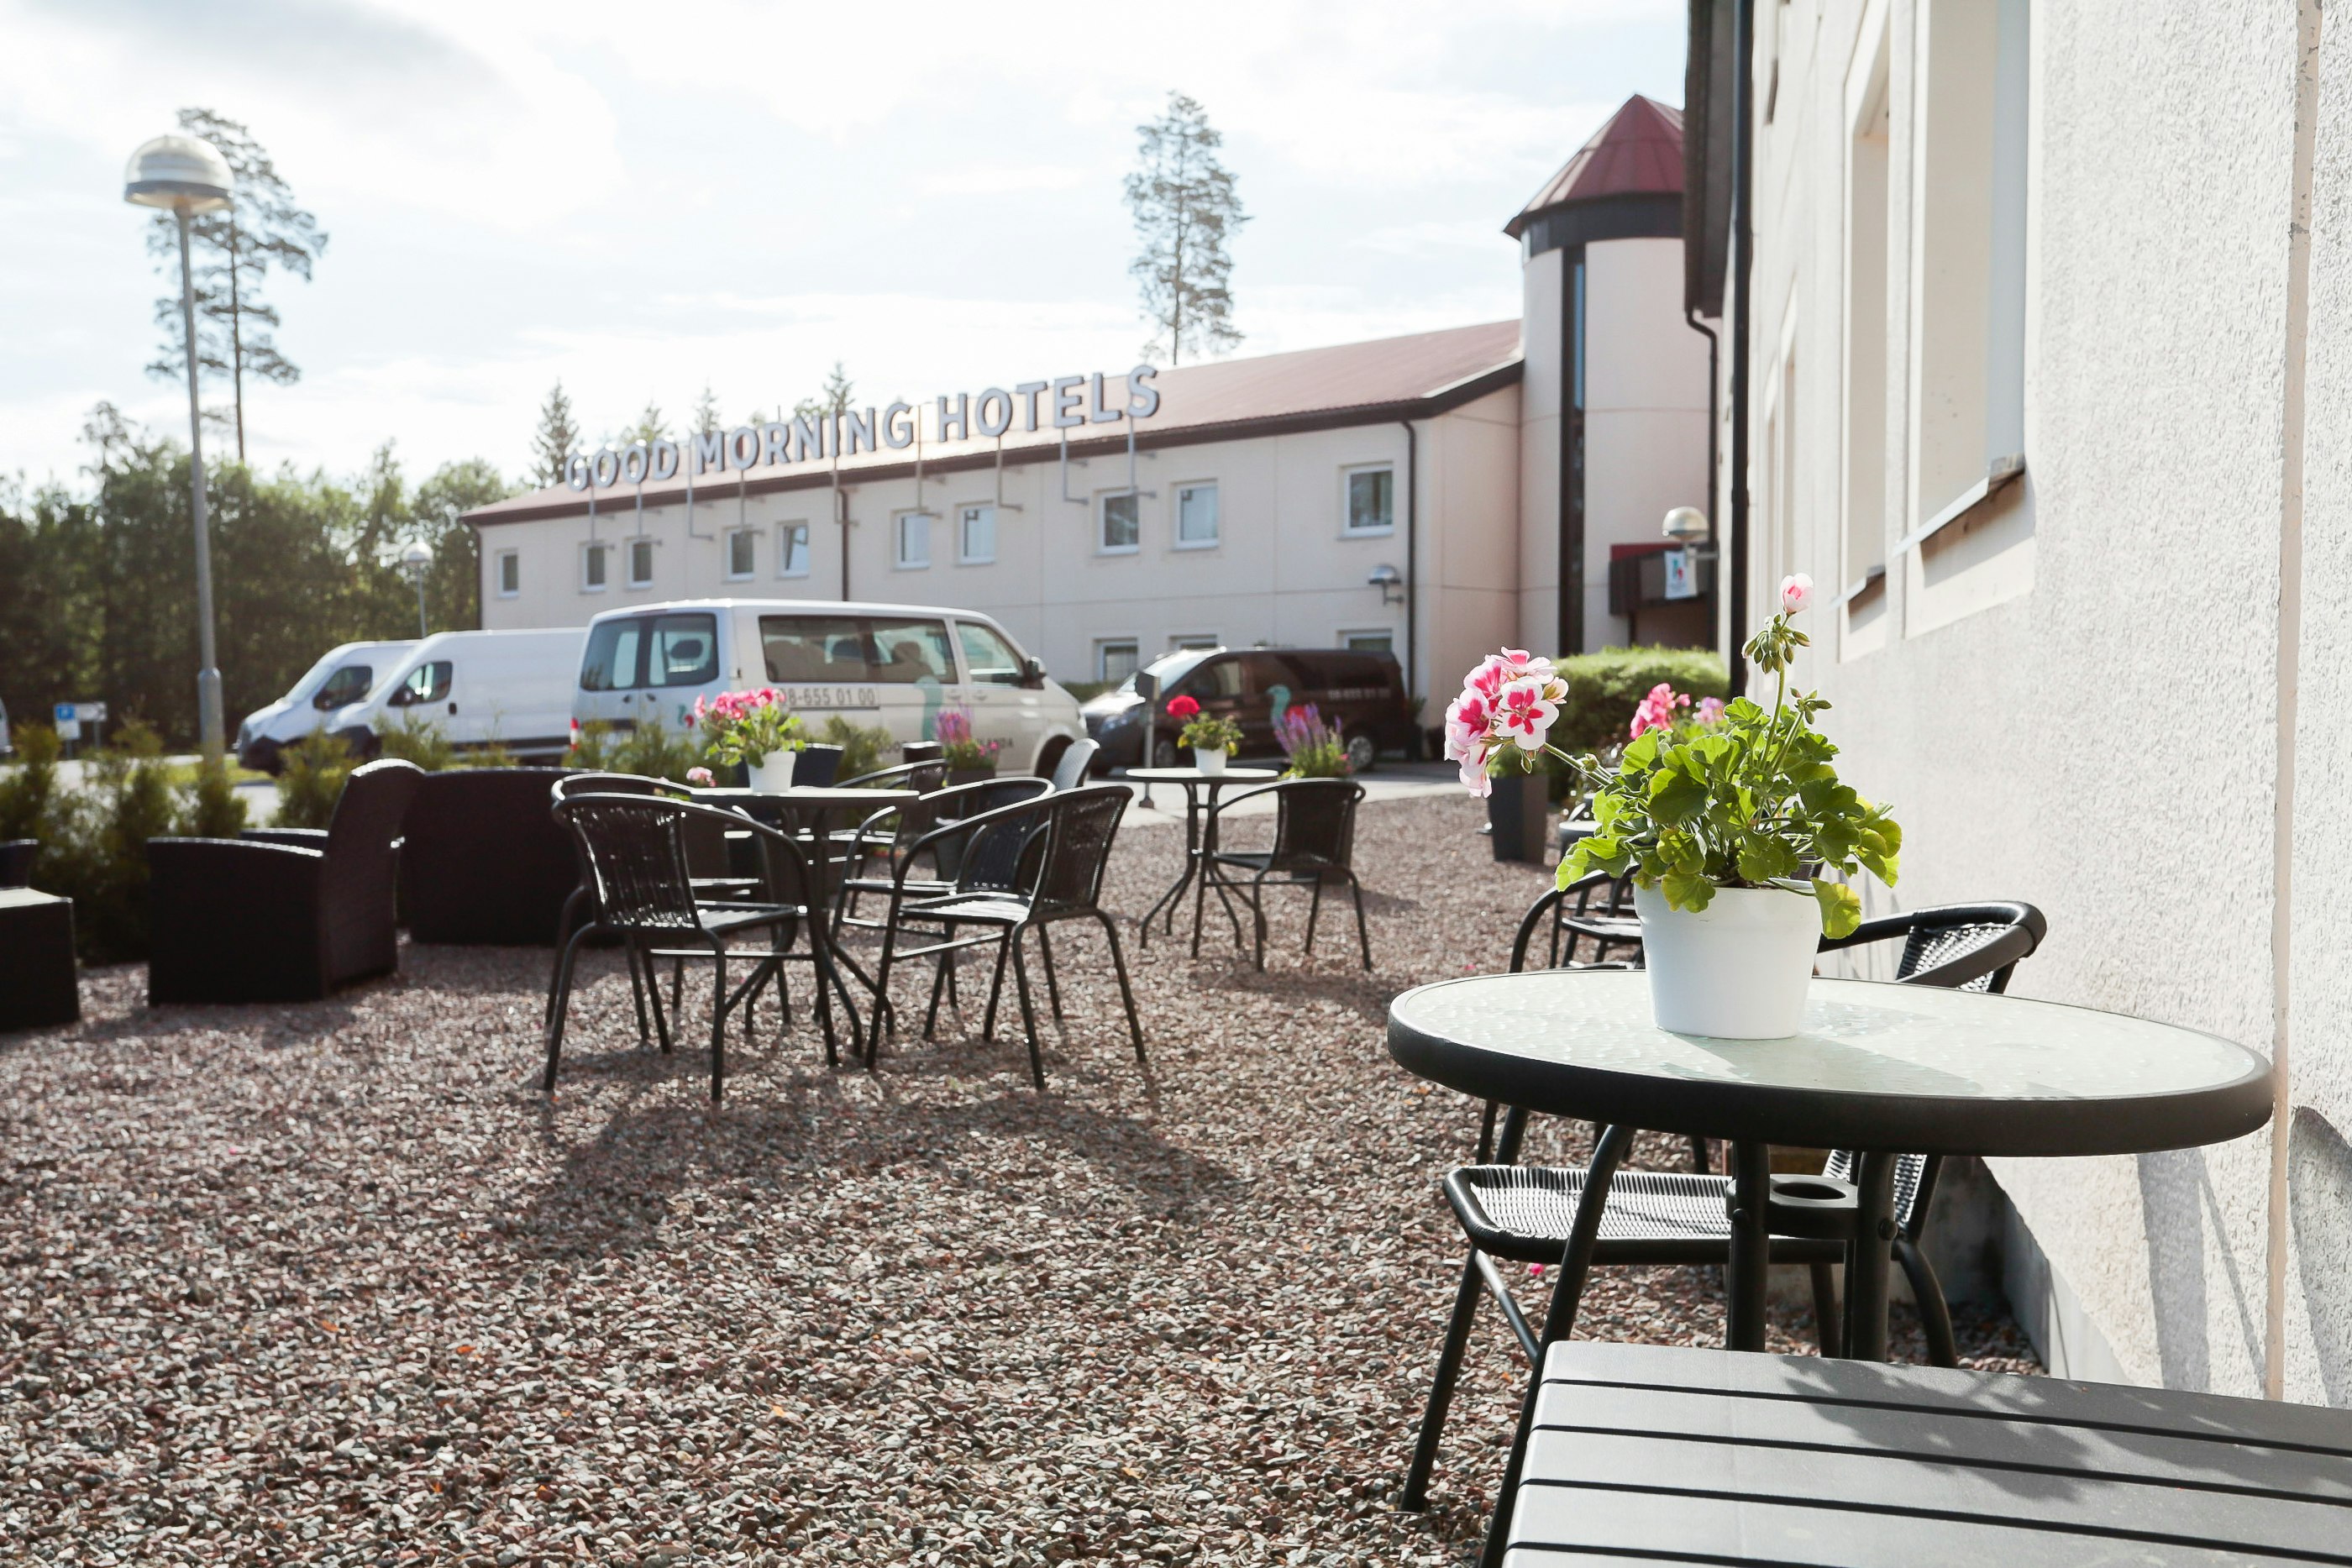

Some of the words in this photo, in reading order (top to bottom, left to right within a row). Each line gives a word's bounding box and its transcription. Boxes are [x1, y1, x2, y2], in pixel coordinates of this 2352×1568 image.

[564, 438, 679, 492] GOOD
[694, 401, 913, 475] MORNING
[937, 364, 1159, 443] HOTELS
